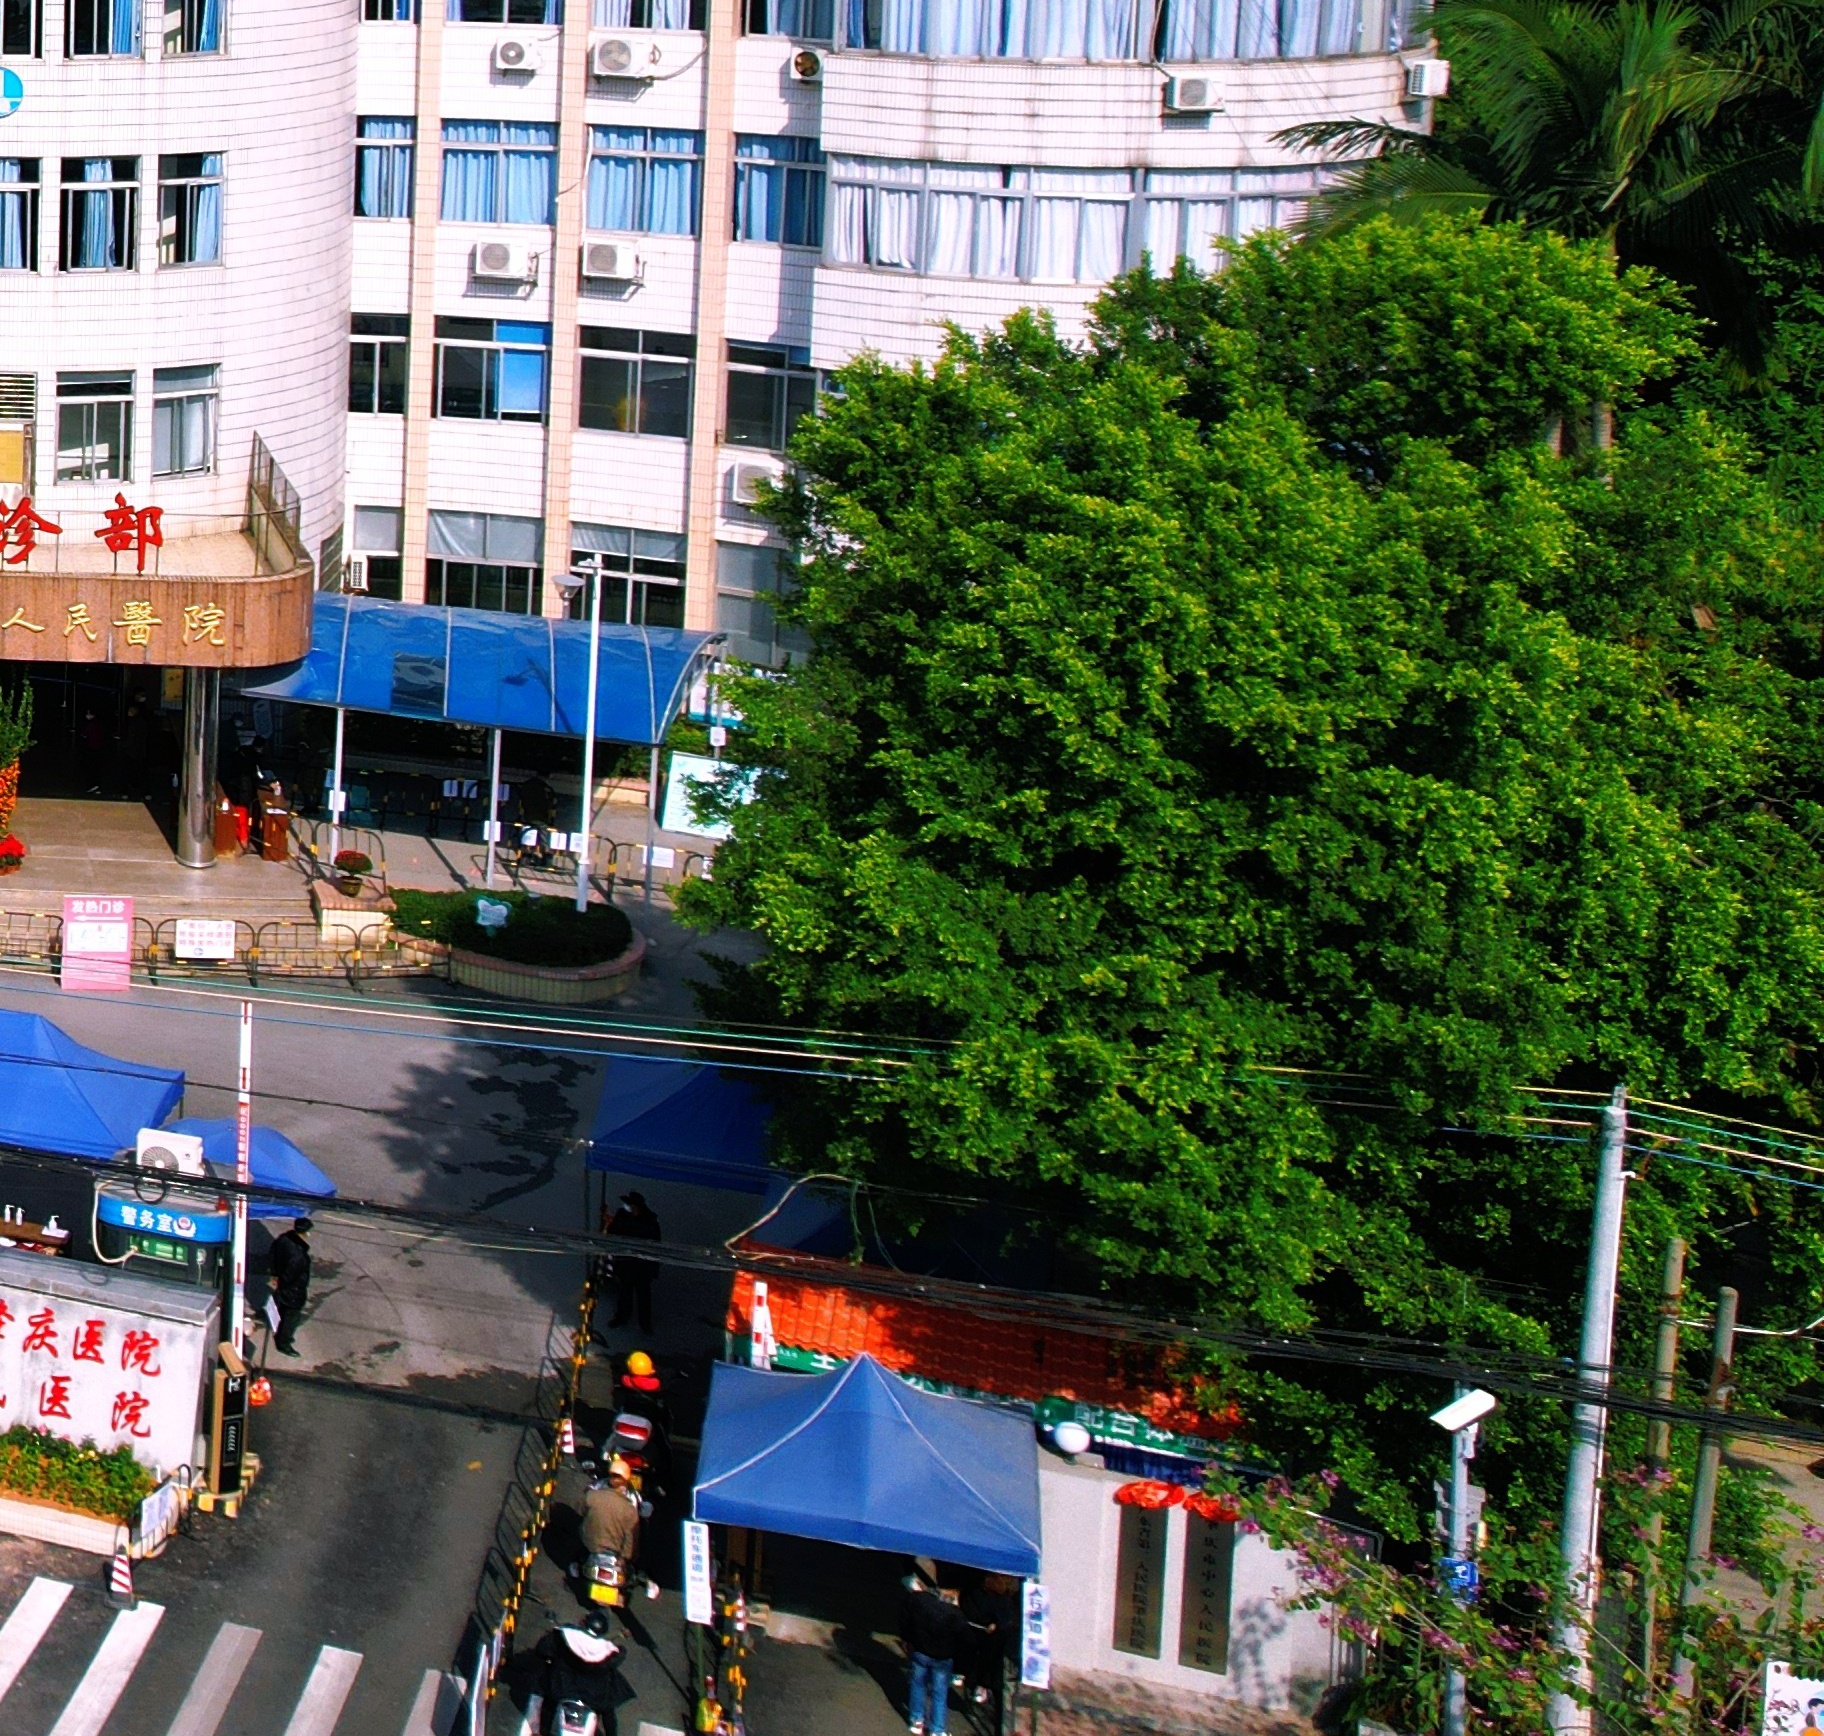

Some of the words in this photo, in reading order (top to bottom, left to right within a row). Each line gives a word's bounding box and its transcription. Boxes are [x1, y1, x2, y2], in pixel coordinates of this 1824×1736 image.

[71, 899, 126, 914] 发热门诊
[120, 1205, 173, 1233] 警务室
